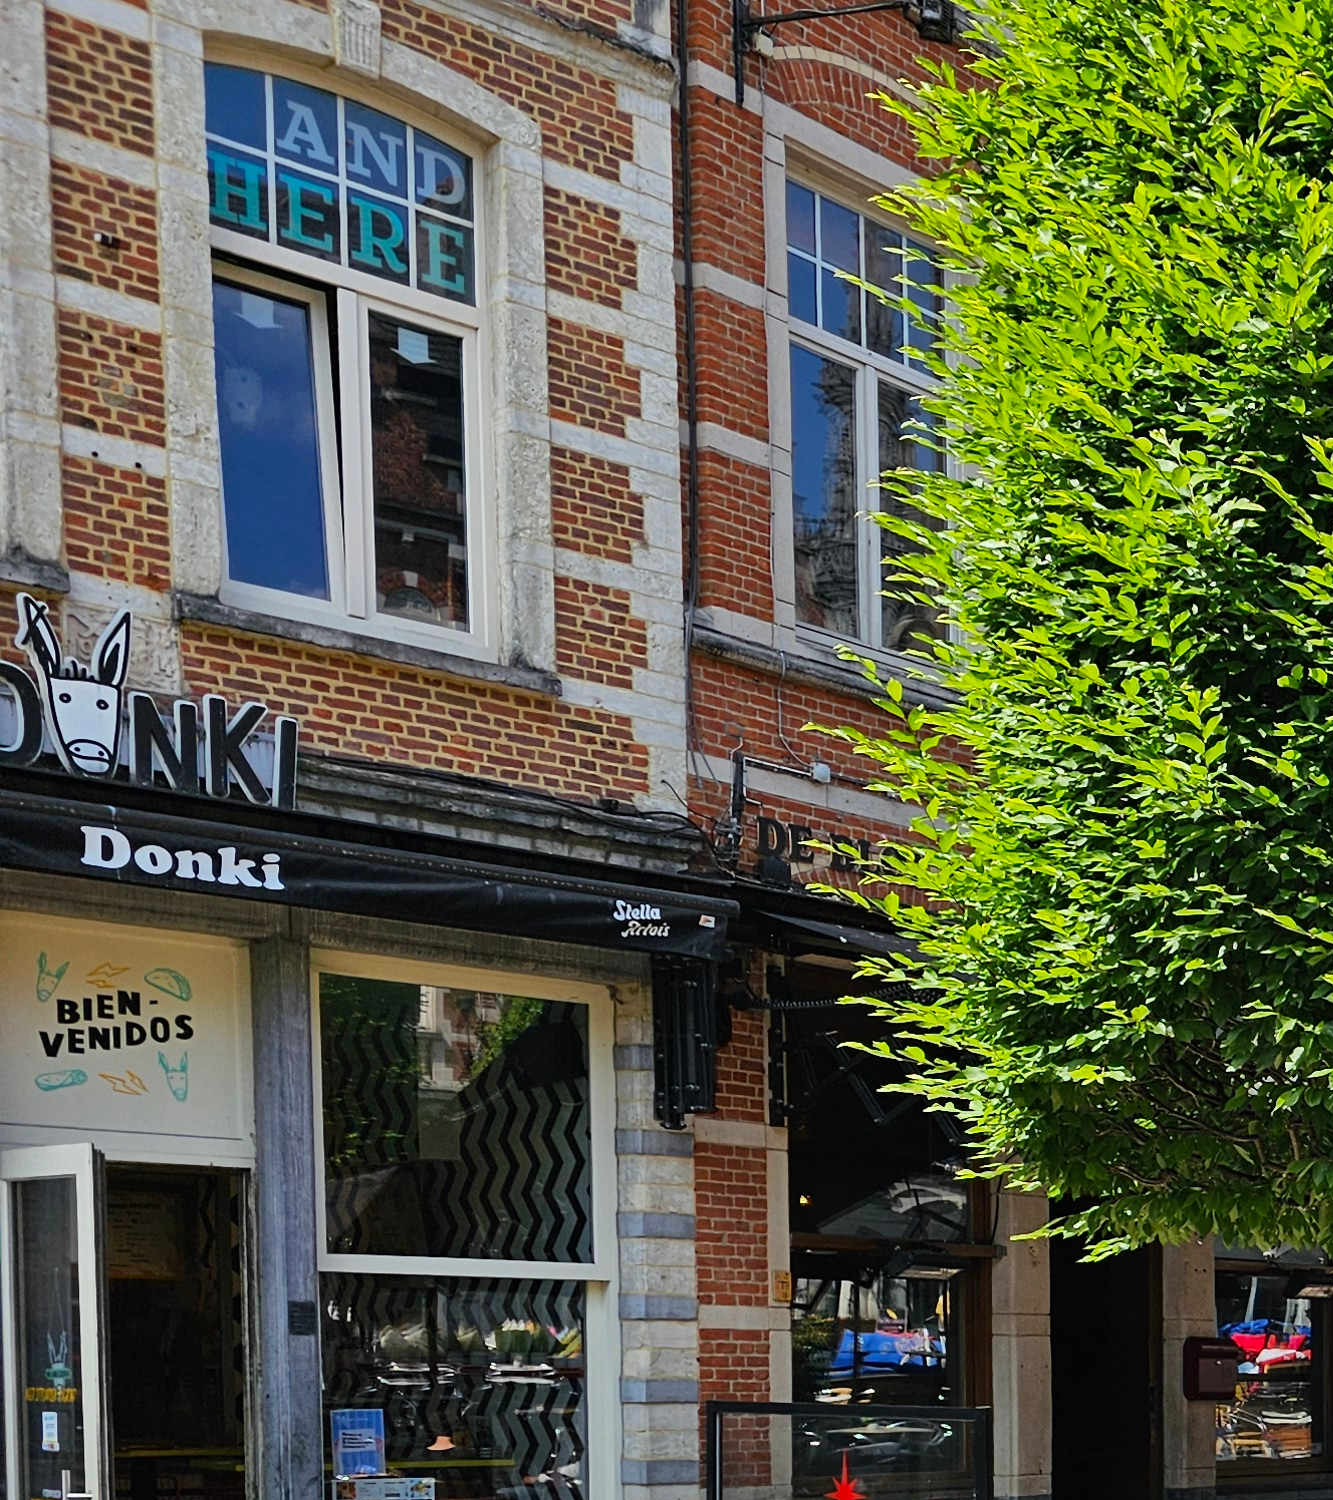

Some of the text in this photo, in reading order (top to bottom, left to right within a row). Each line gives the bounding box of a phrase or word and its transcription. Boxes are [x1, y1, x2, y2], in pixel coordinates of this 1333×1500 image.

[276, 100, 466, 204] AND
[207, 150, 465, 295] HERE
[80, 825, 285, 890] Donki
[613, 899, 662, 921] Stella
[621, 920, 671, 938] Artois
[38, 1014, 194, 1058] VENIDOS
